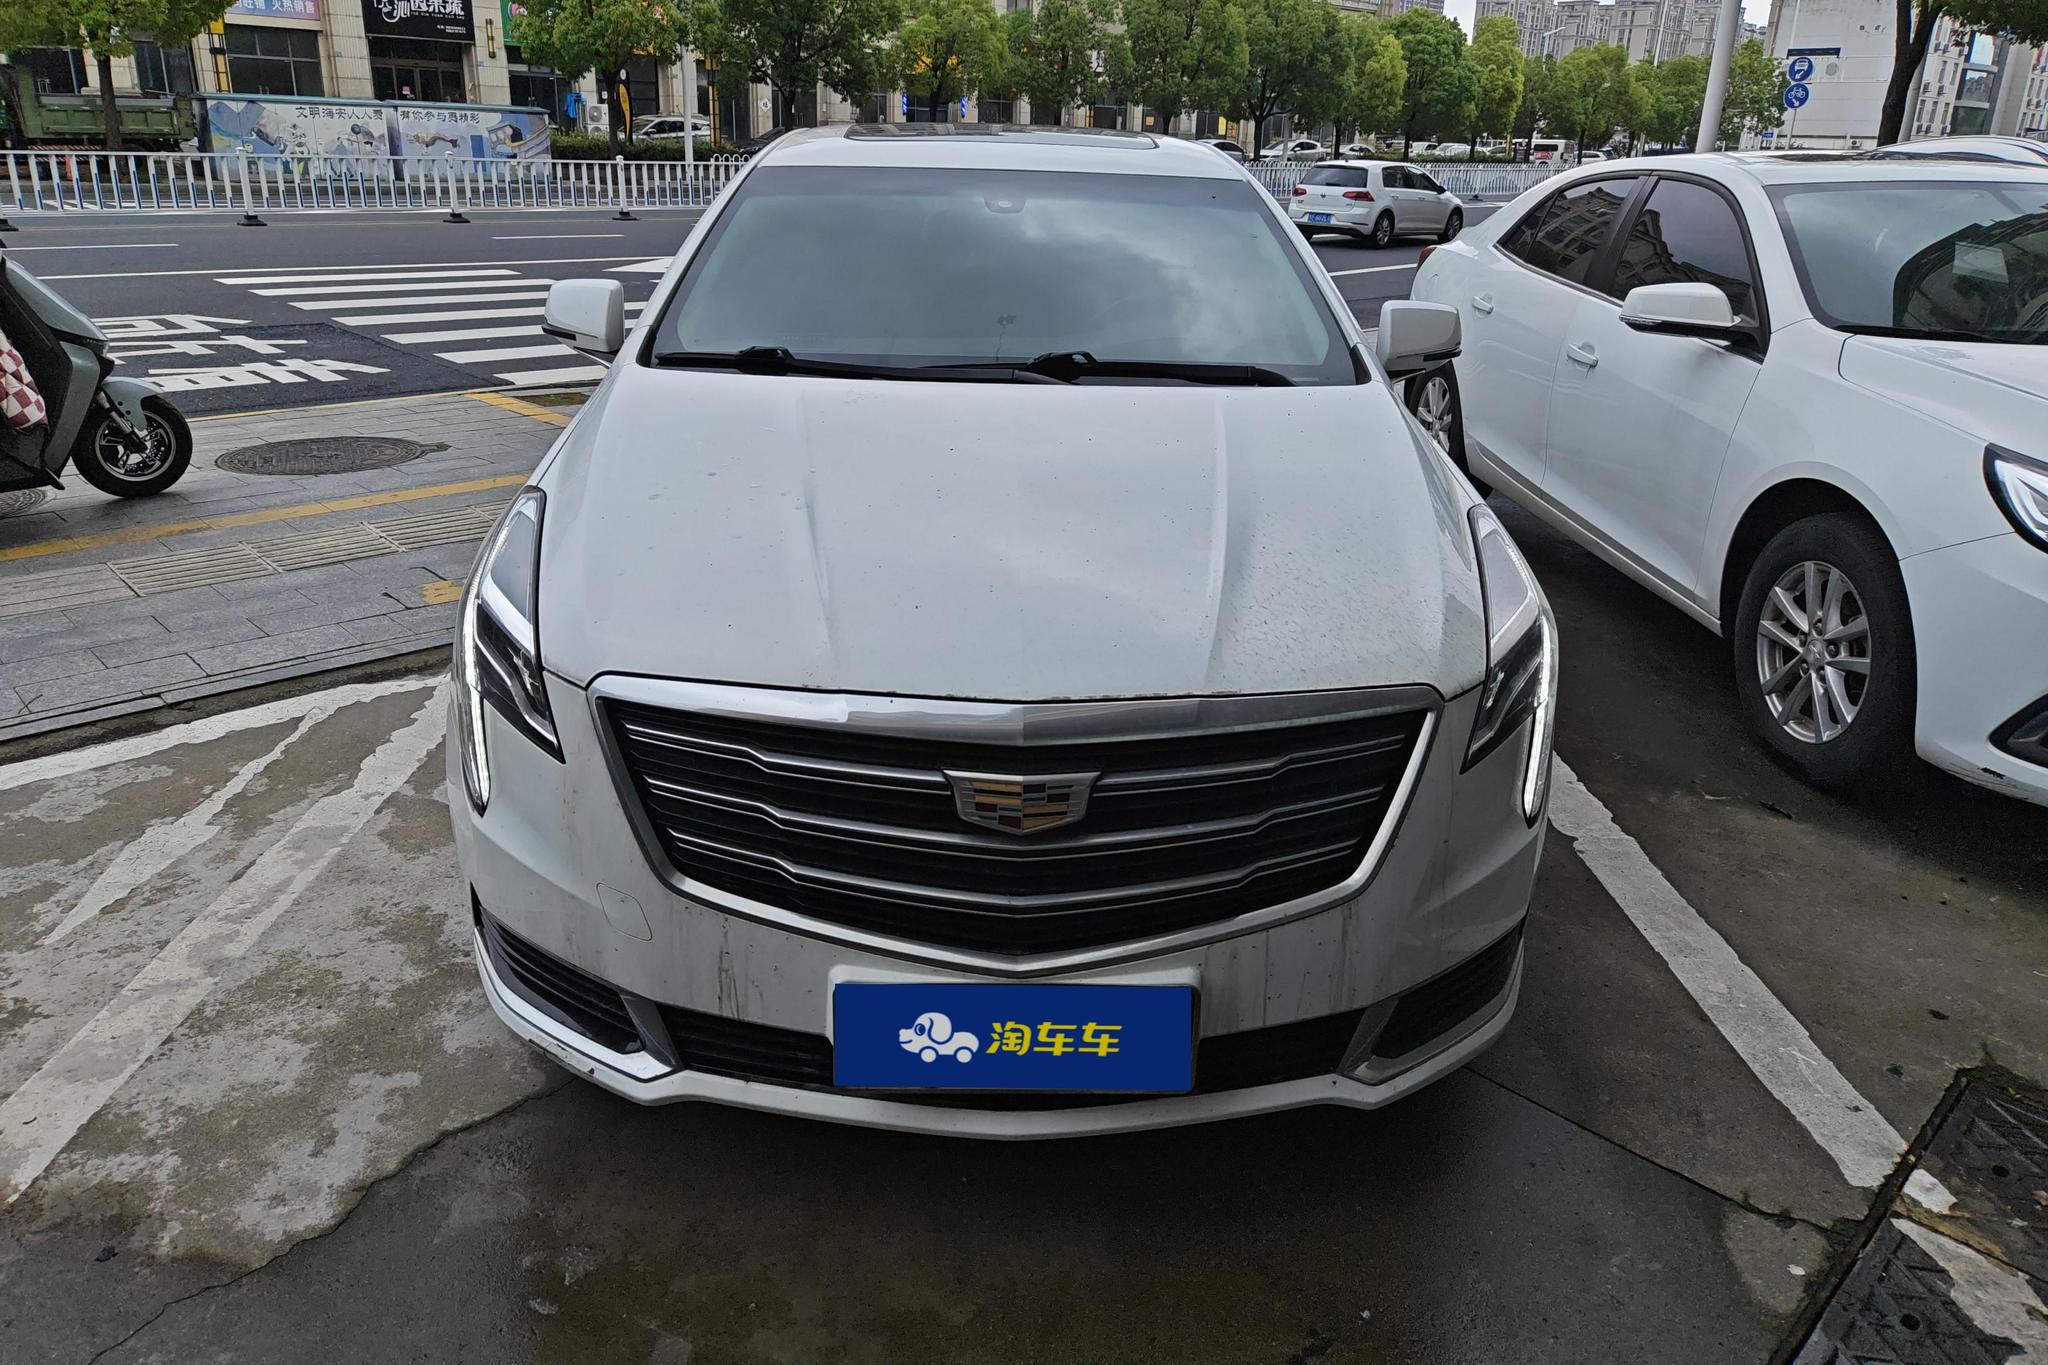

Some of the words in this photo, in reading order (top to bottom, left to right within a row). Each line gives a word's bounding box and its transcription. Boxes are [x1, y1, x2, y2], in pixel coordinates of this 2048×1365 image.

[399, 110, 480, 125] 有你参与更精彩
